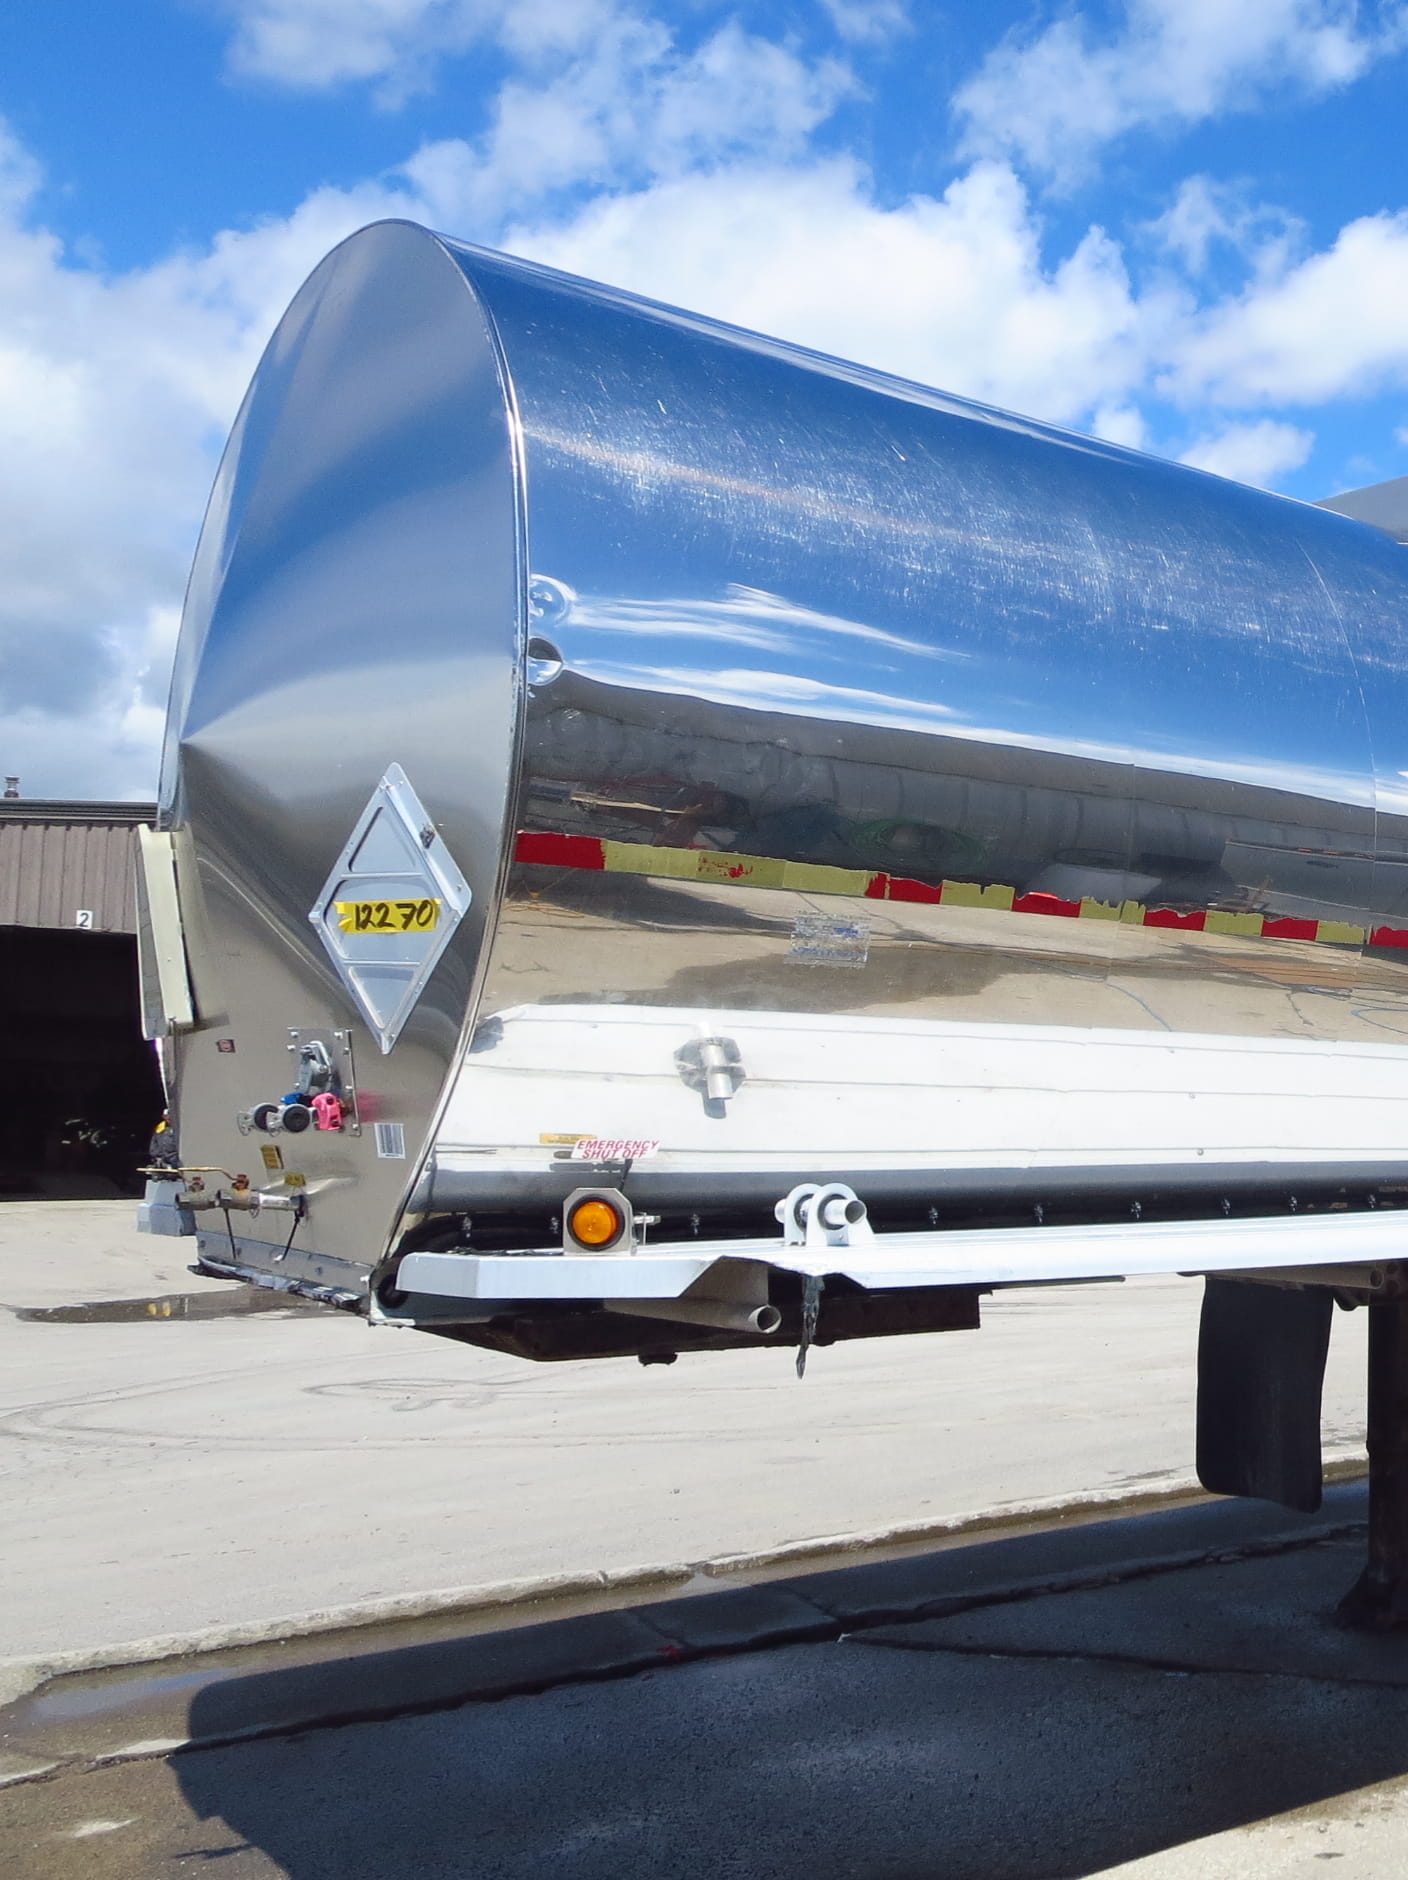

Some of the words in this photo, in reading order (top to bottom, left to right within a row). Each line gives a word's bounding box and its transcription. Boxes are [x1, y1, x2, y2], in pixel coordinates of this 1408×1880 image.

[79, 912, 89, 927] 2
[354, 899, 434, 931] 12270
[577, 1140, 659, 1150] EMERGENCY
[582, 1149, 619, 1159] SHUT
[621, 1149, 648, 1159] OFF
